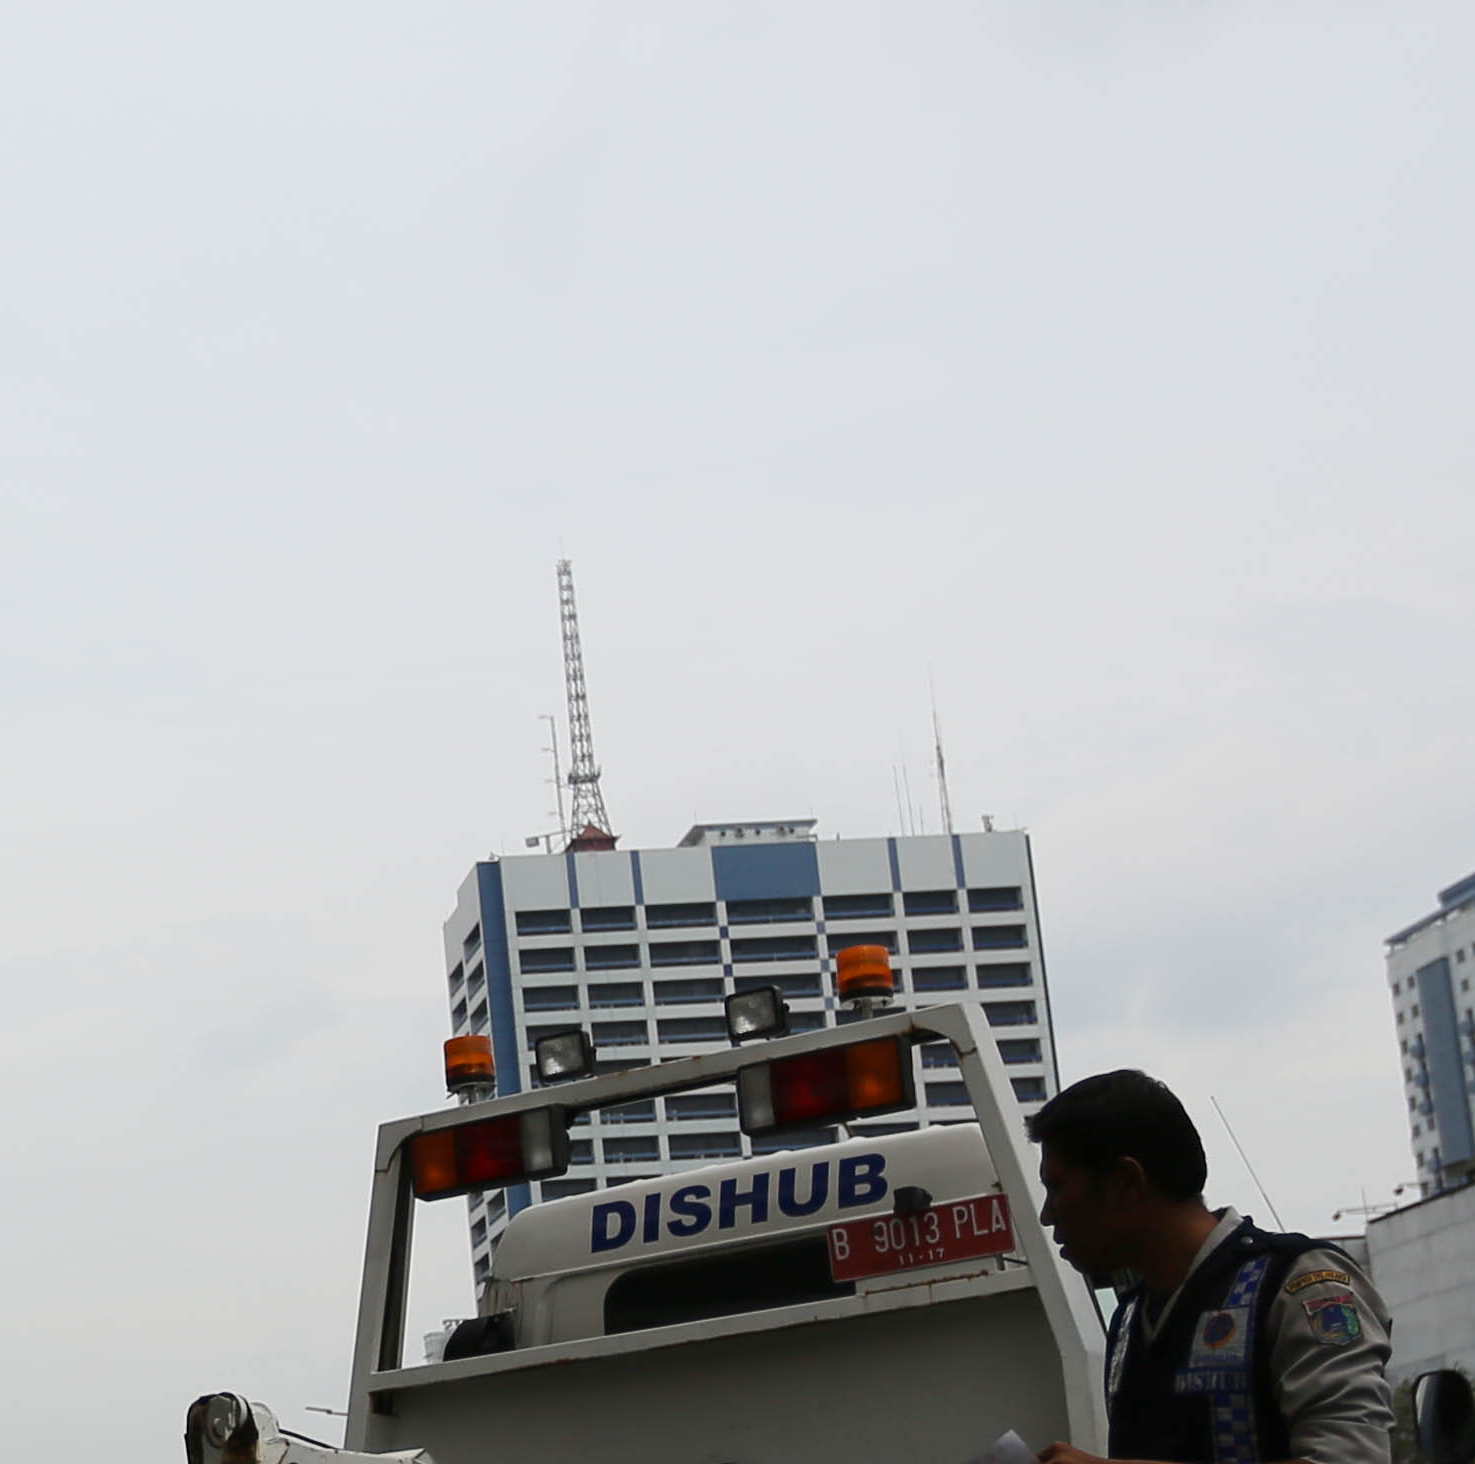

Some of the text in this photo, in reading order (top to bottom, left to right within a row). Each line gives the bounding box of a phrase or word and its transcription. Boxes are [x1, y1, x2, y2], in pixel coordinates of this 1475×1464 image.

[591, 1152, 889, 1254] DISHUB
[831, 1199, 1007, 1261] B 9013 PLA
